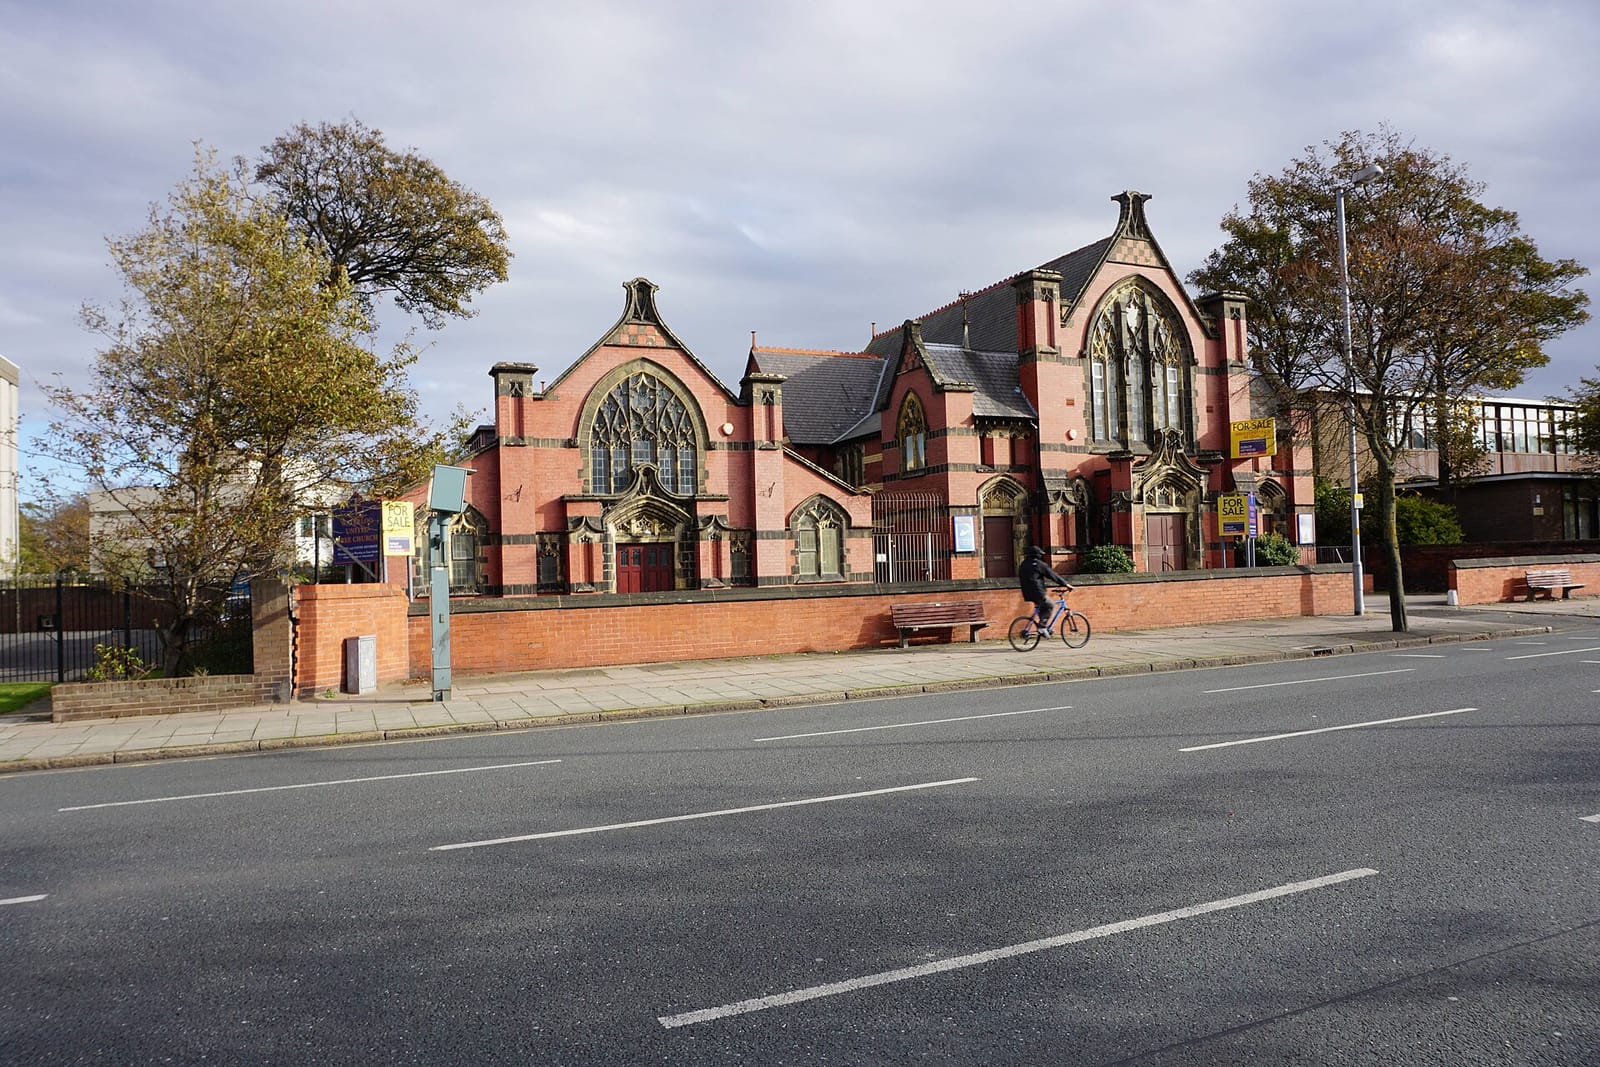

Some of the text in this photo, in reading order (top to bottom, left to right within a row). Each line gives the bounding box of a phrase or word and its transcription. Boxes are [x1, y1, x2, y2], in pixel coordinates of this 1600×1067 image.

[1232, 420, 1272, 431] FOR SALE
[1223, 498, 1243, 508] FOR
[388, 505, 408, 516] FOR
[1222, 507, 1245, 516] SALE
[387, 516, 411, 528] SALE
